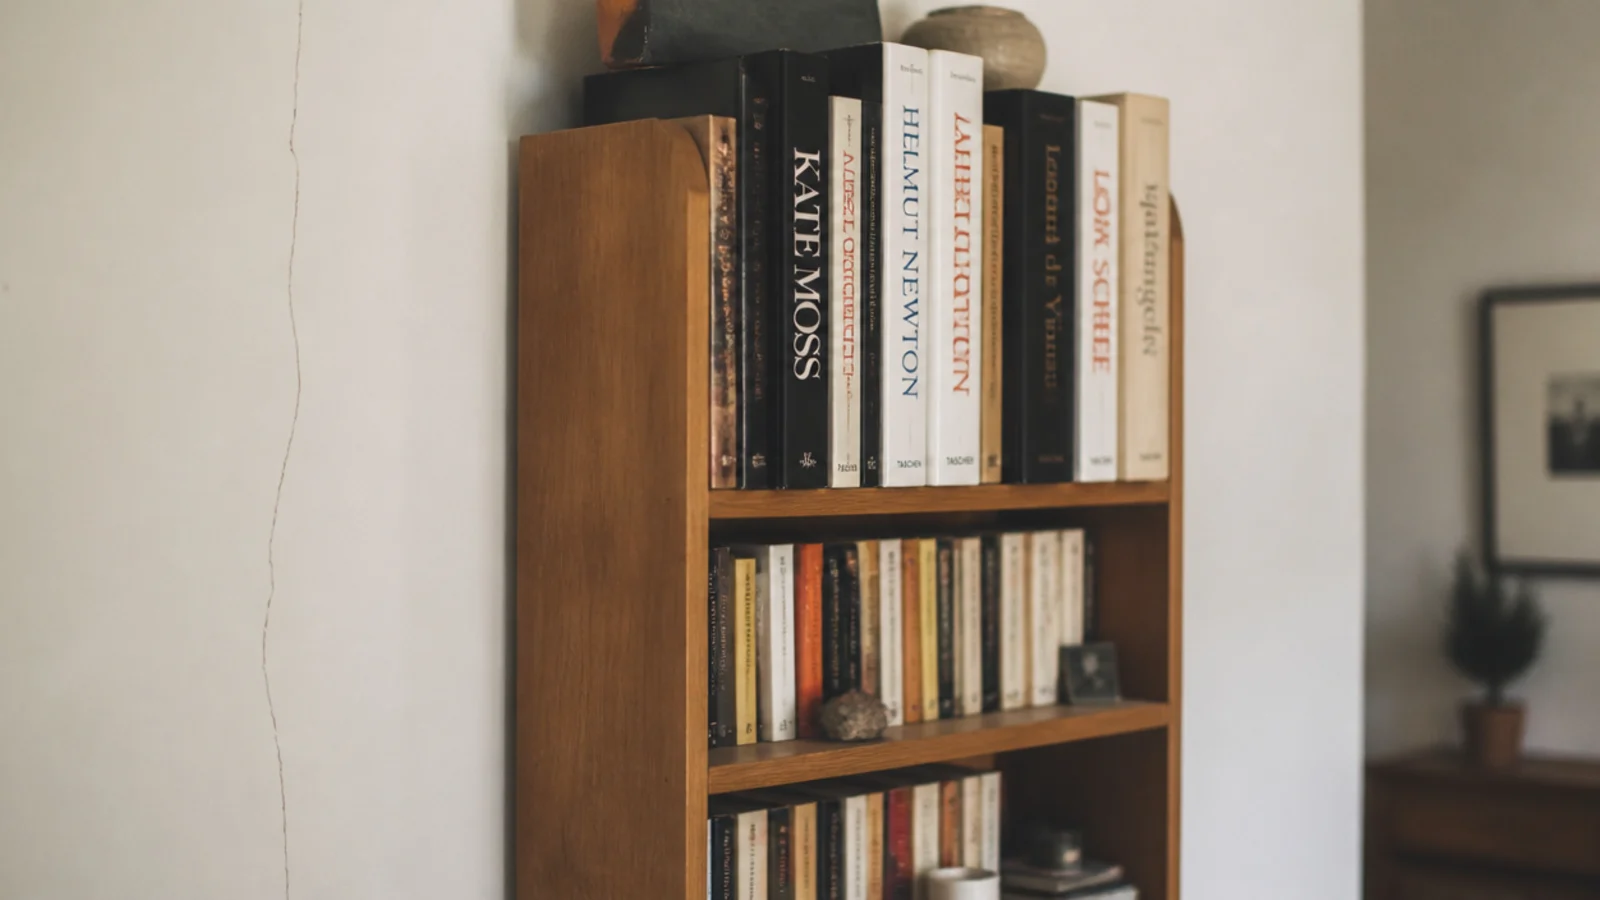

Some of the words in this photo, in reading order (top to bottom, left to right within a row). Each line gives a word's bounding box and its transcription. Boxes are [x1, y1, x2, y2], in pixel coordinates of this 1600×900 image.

[793, 147, 820, 258] KATE
[902, 105, 919, 240] HELMUT
[793, 264, 821, 381] MOSS
[901, 251, 919, 399] NEWTON
